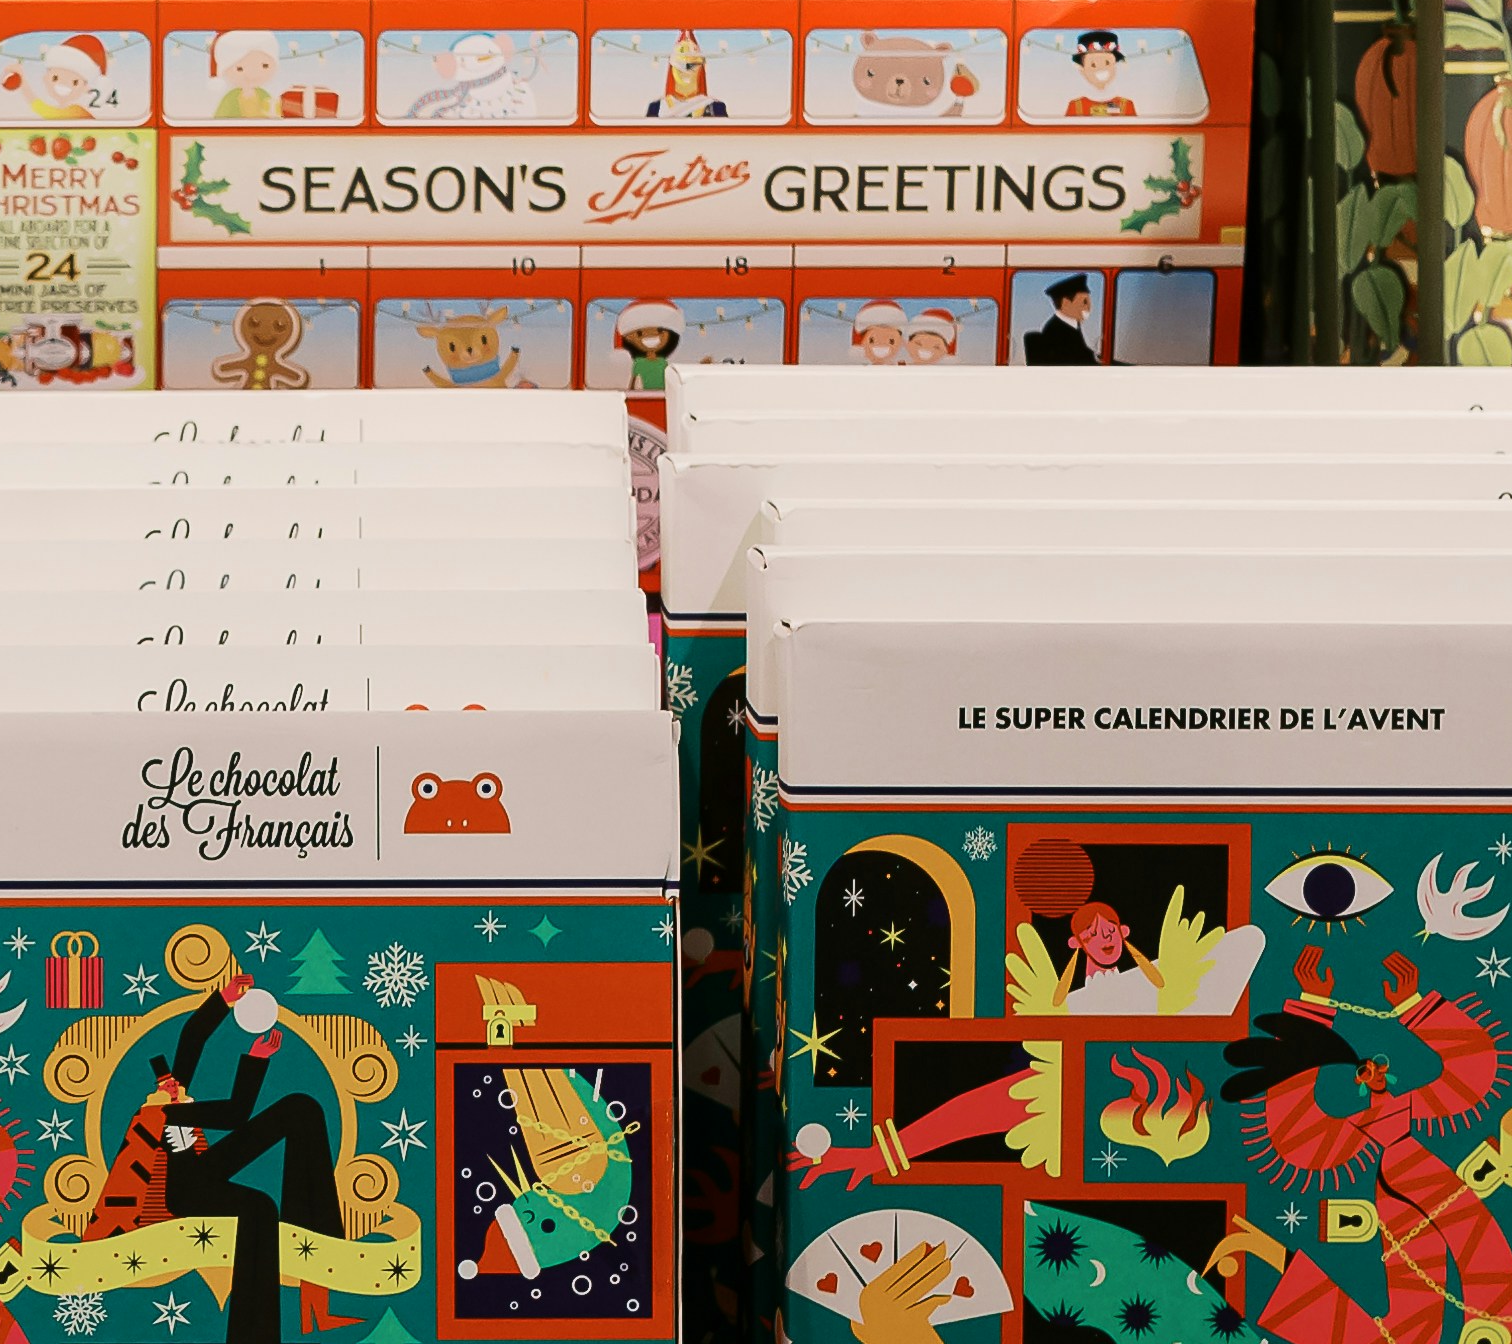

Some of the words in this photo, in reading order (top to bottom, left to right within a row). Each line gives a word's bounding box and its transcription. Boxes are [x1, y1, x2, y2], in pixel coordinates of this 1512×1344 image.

[2, 163, 107, 190] MERRY
[259, 166, 568, 213] SEASON'S
[583, 148, 752, 226] Tiptree
[764, 164, 1128, 212] GREETINGS
[26, 252, 81, 282] 24
[959, 707, 985, 730] LE
[996, 707, 1086, 730] SUPER
[1095, 707, 1271, 730] CALENDRIER
[1280, 708, 1314, 730] DE
[1324, 708, 1446, 731] L'AVENT
[141, 746, 205, 809] Le
[209, 751, 341, 797] chocolat
[122, 803, 170, 848] des
[182, 798, 354, 861] Français
